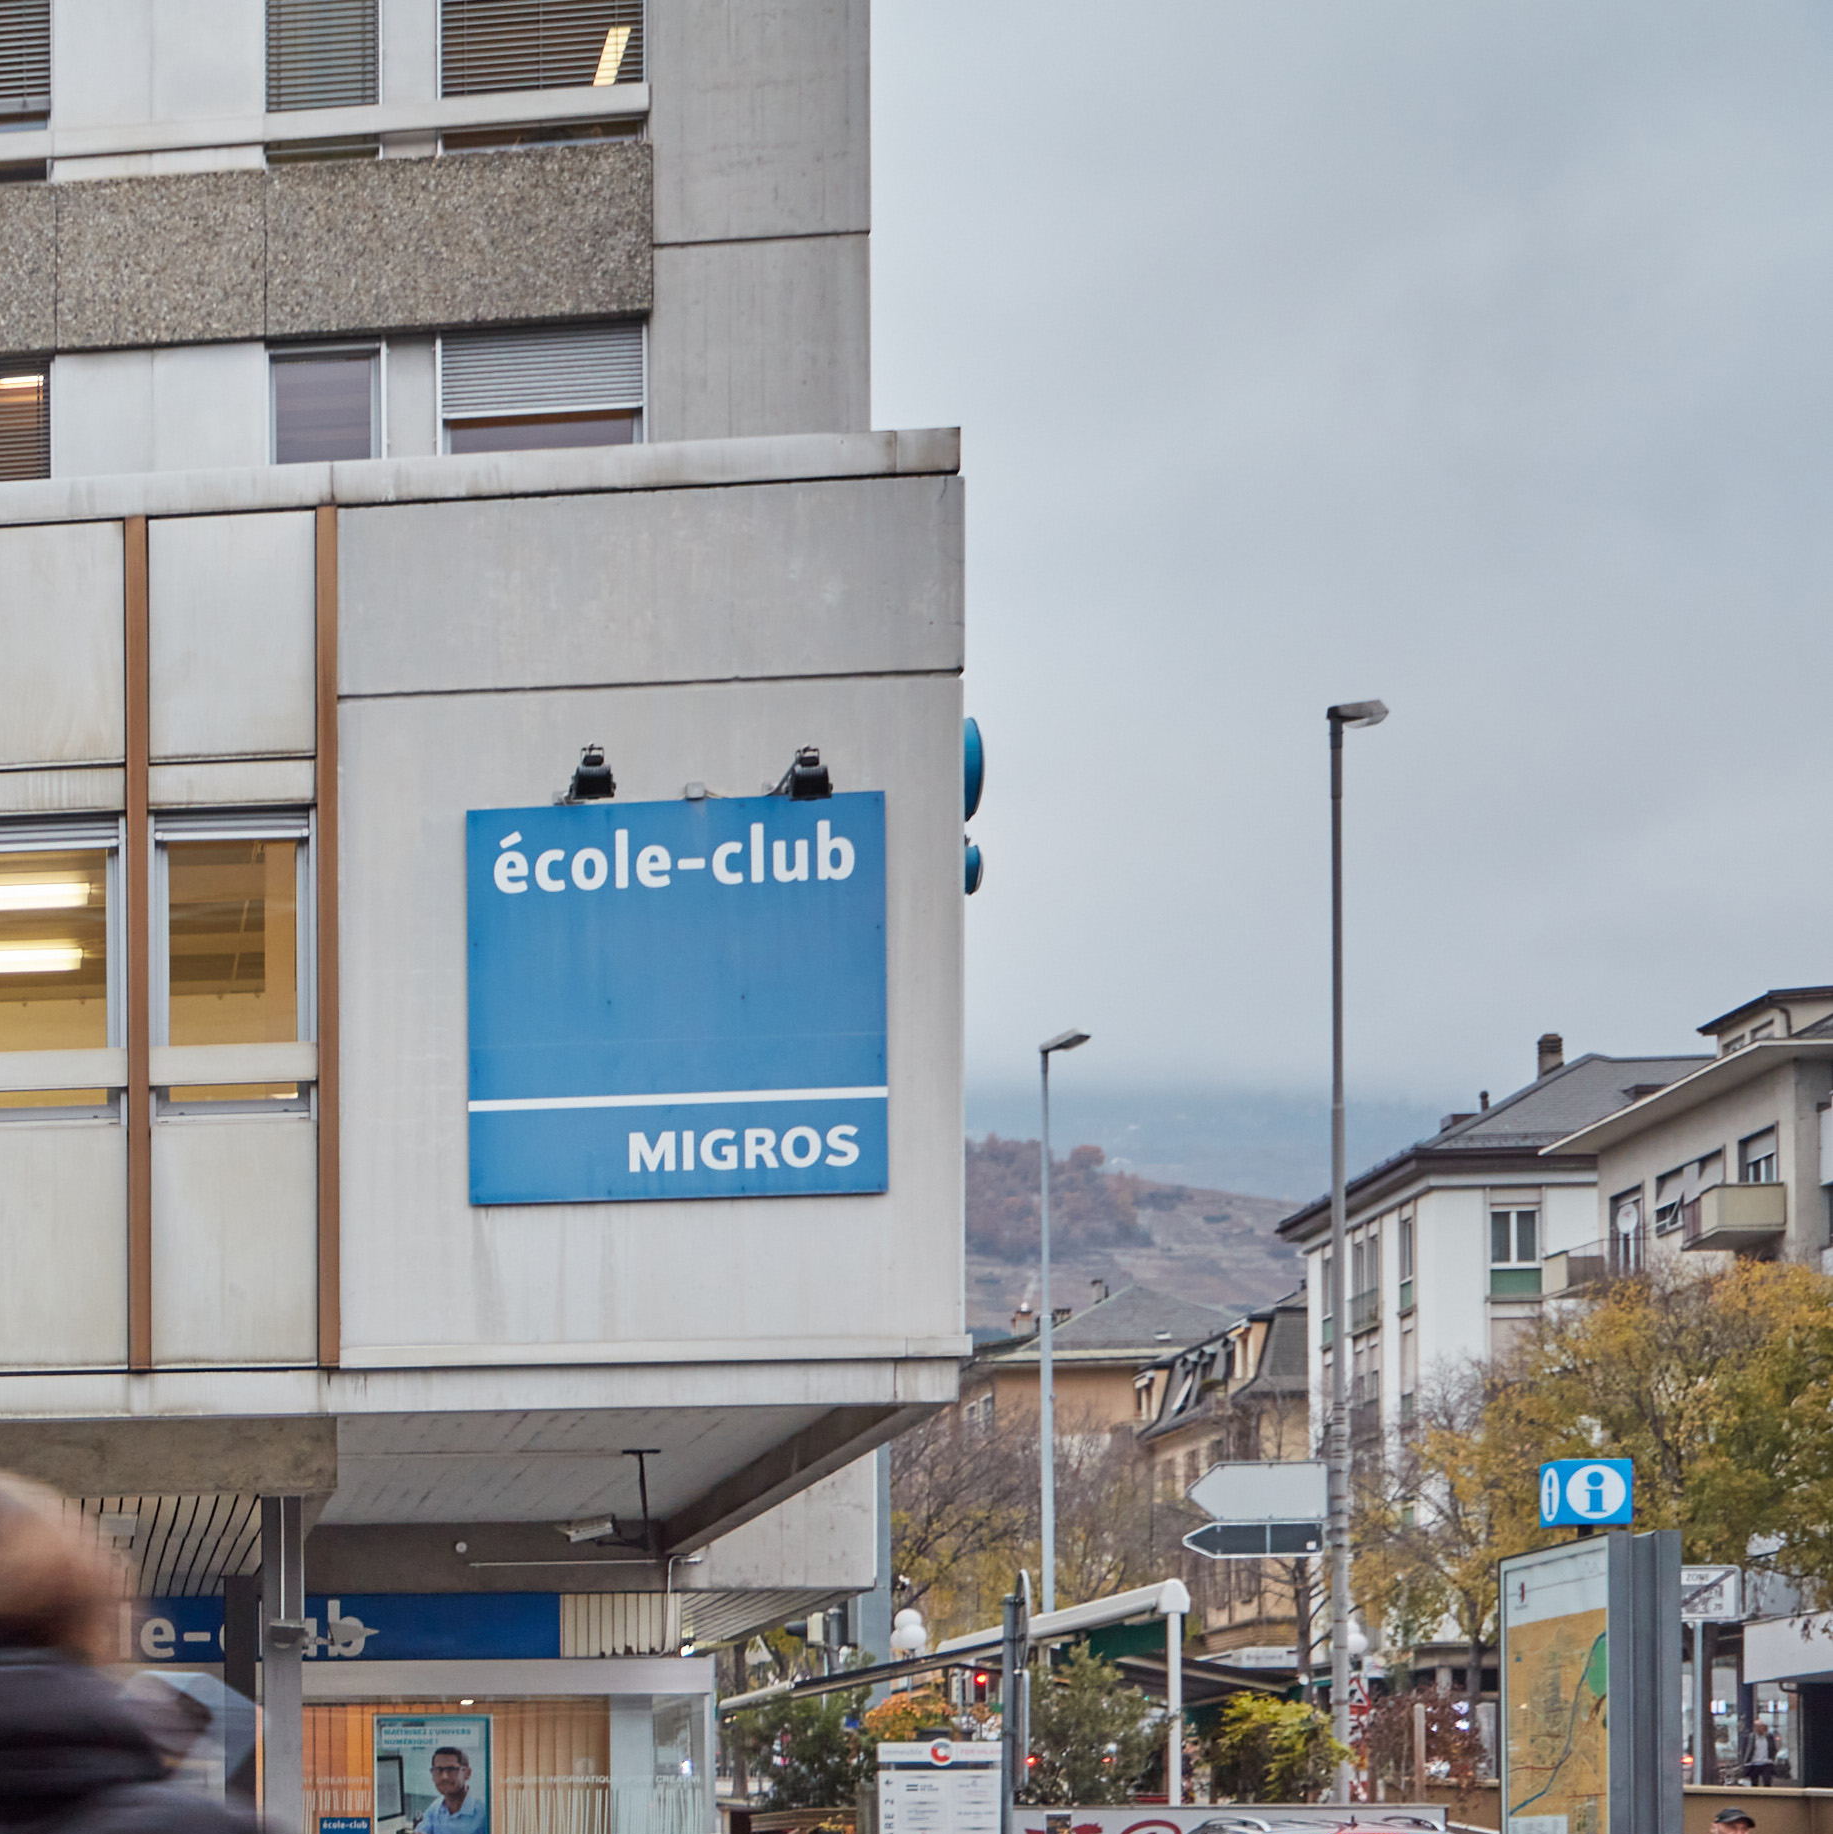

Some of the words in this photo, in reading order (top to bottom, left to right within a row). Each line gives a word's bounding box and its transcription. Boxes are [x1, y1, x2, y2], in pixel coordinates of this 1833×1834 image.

[492, 819, 856, 894] école-club
[628, 1125, 860, 1172] MIGROS
[546, 1775, 617, 1784] INFORMATIQU
[322, 1816, 368, 1829] école-club
